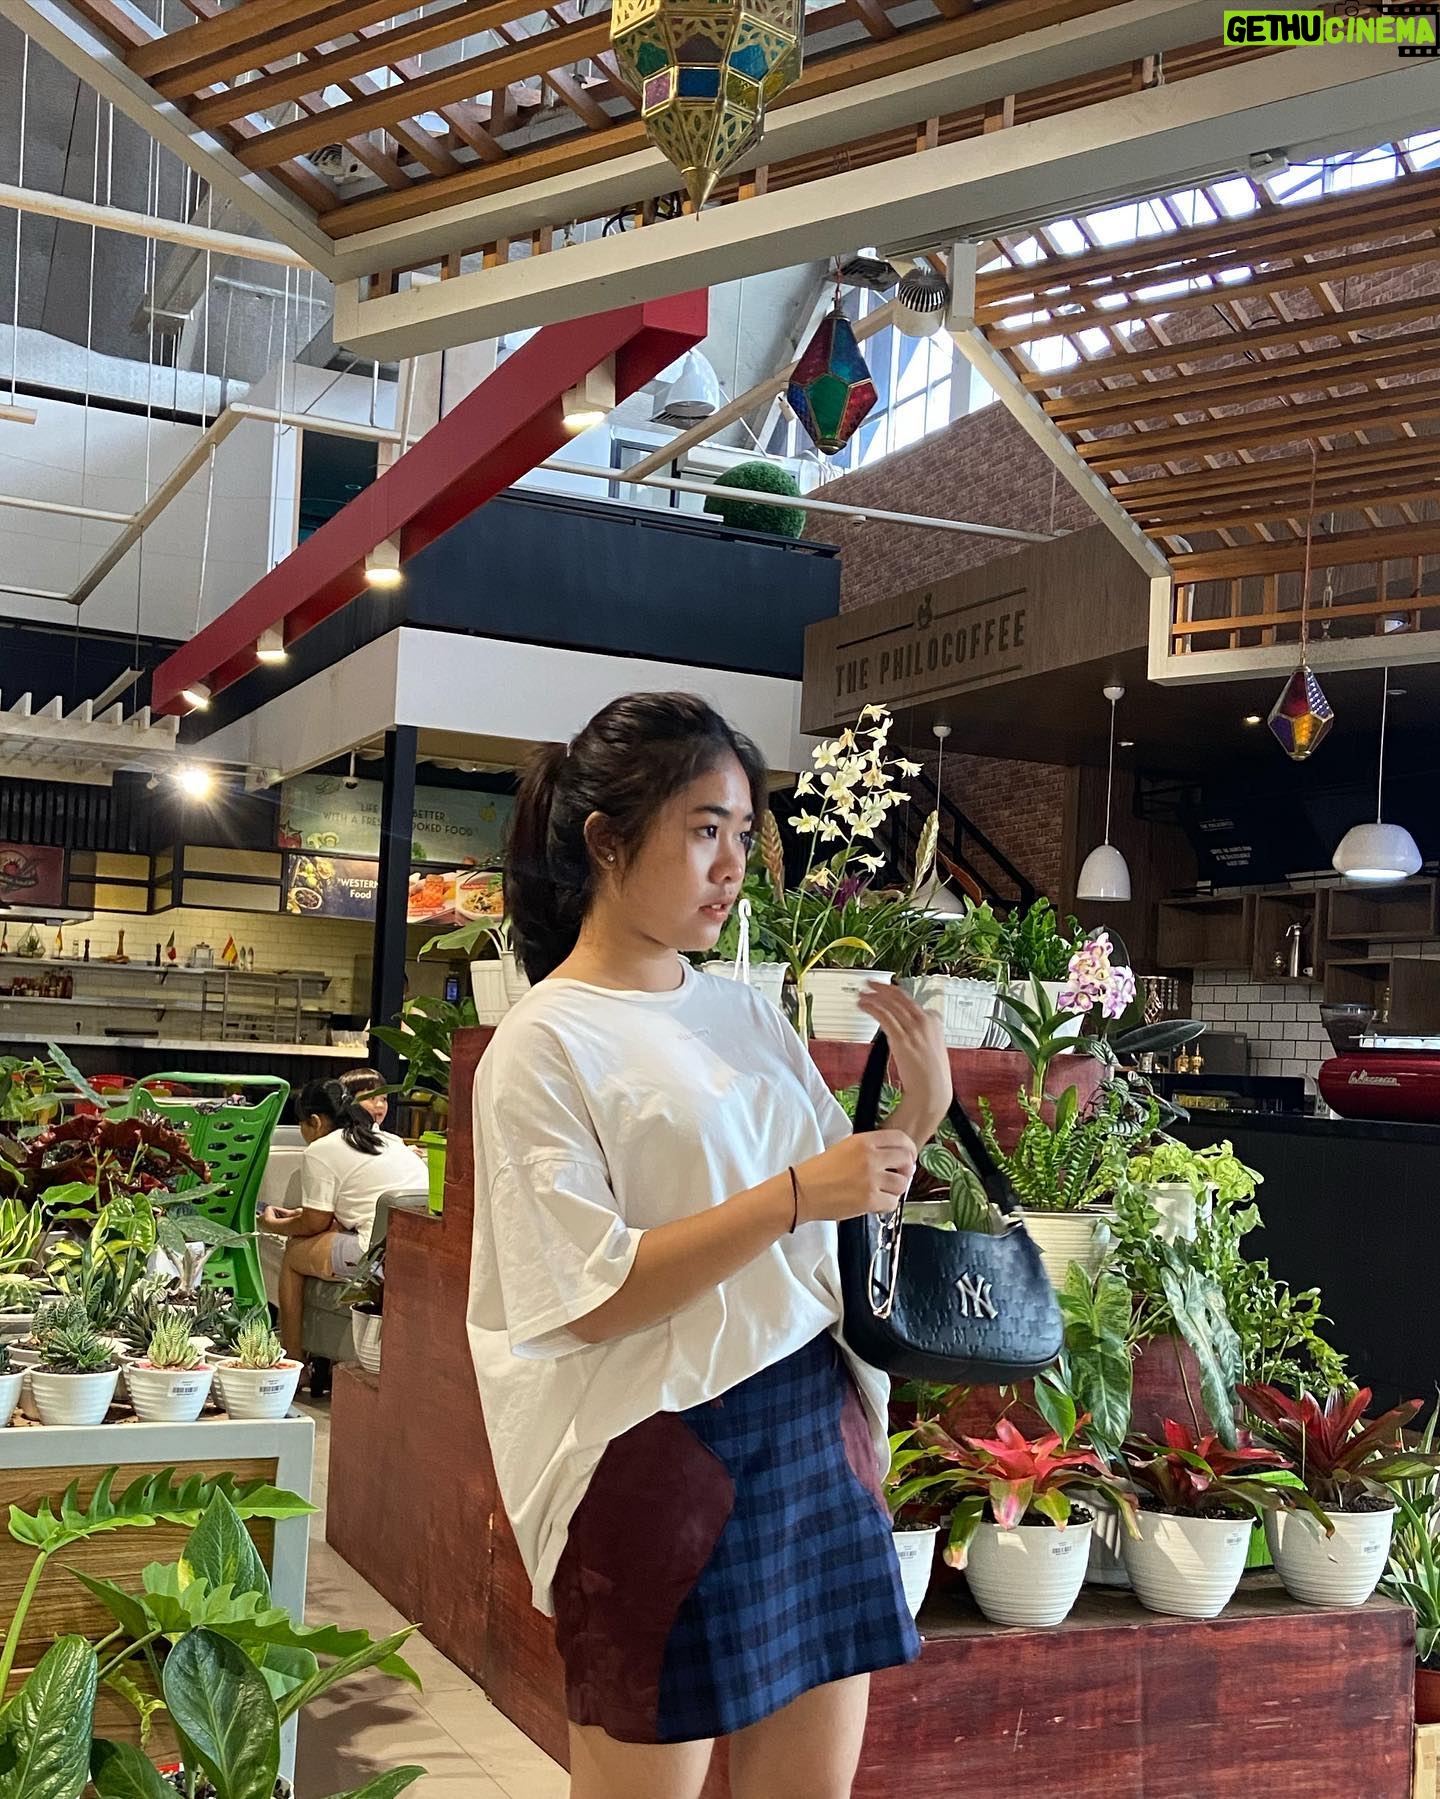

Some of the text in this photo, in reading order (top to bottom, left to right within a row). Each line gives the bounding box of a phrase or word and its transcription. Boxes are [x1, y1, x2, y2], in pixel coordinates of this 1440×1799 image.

[836, 609, 1026, 697] THE PHILOCOFFEE
[322, 811, 347, 825] WITH
[351, 814, 358, 824] A
[350, 889, 372, 899] Food
[954, 1271, 999, 1320] NY
